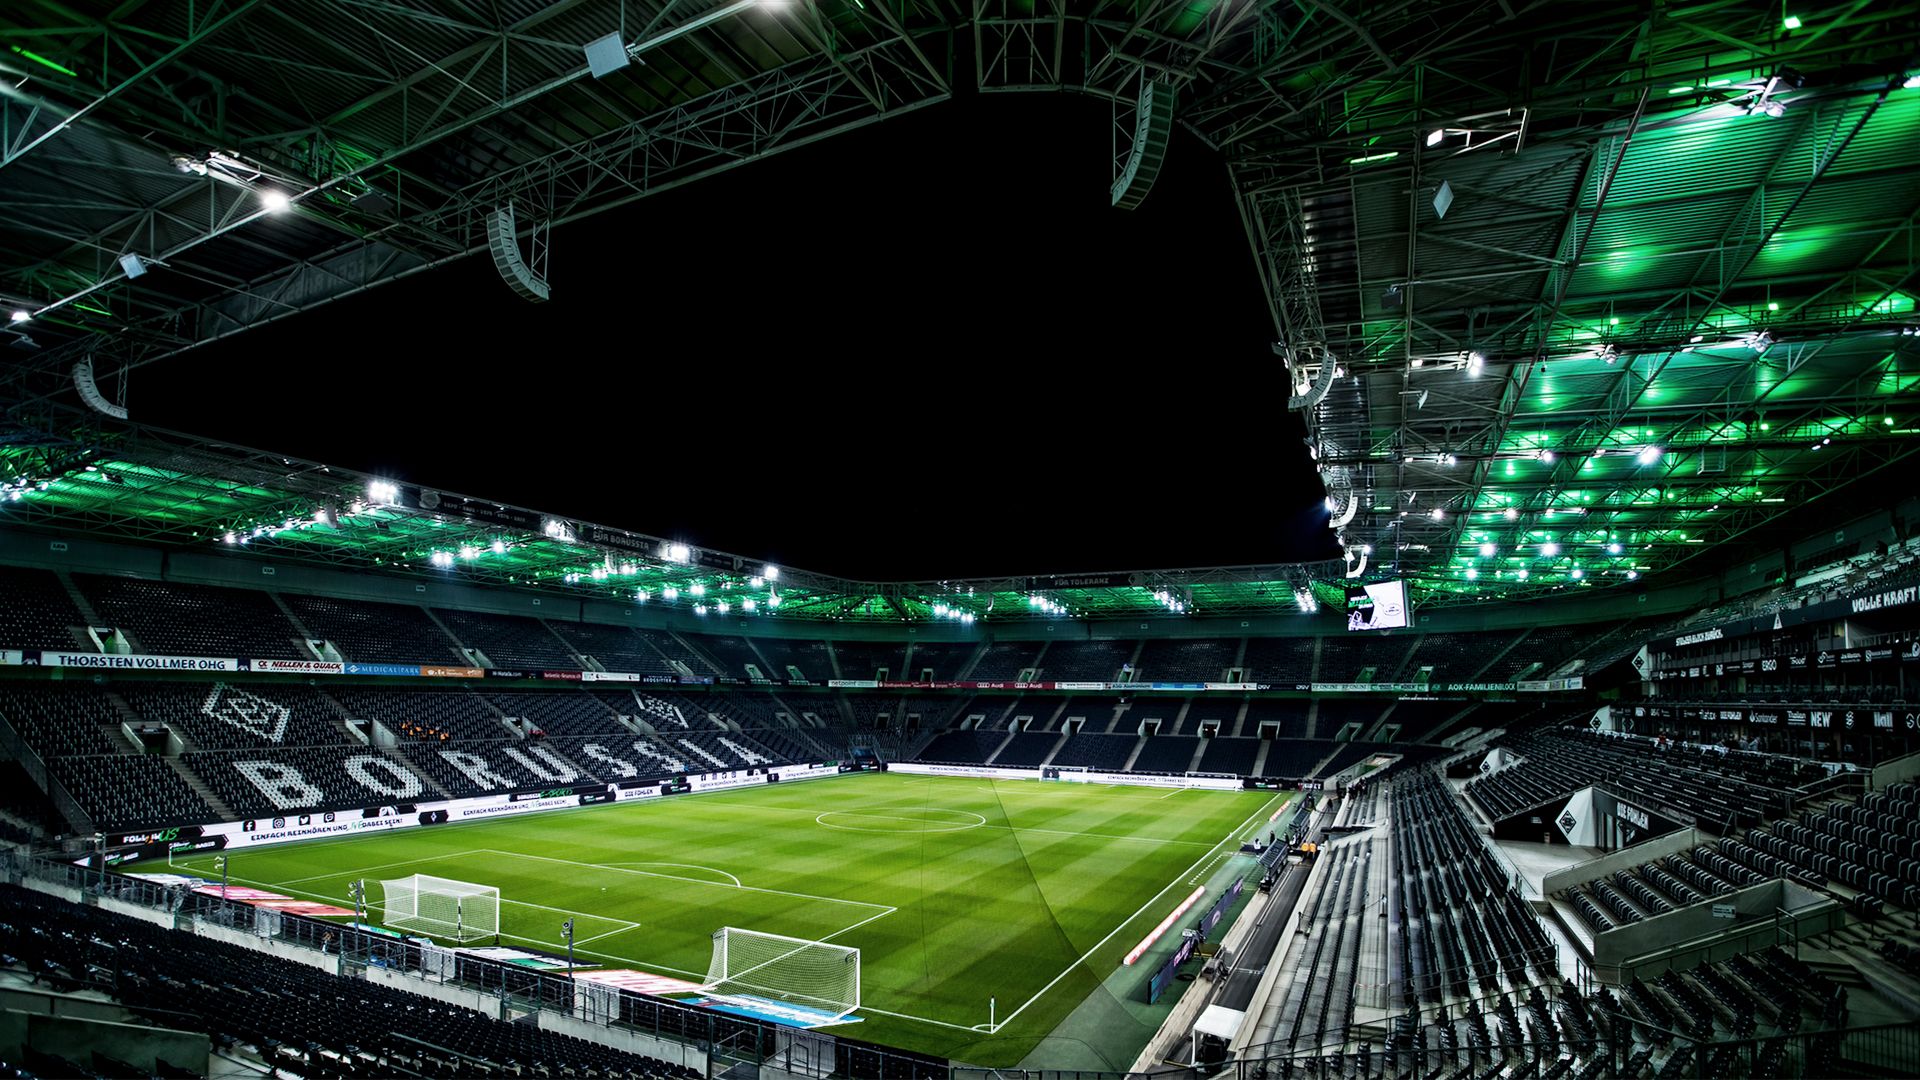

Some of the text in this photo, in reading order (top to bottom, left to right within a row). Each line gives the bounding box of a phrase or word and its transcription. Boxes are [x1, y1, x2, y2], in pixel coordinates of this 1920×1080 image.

[1852, 586, 1917, 613] VOLLE KRAFT
[58, 655, 225, 670] THORSTEN VOLLMER OHG
[313, 662, 342, 670] QUACK
[361, 665, 398, 674] MEDICAL
[400, 666, 419, 674] PARK
[232, 737, 773, 811] BORUSSIA
[123, 832, 161, 843] FOLLW
[251, 831, 286, 841] EINFACH
[287, 825, 331, 837] REINHÖREN
[332, 824, 348, 832] UND
[362, 820, 383, 828] DABEI
